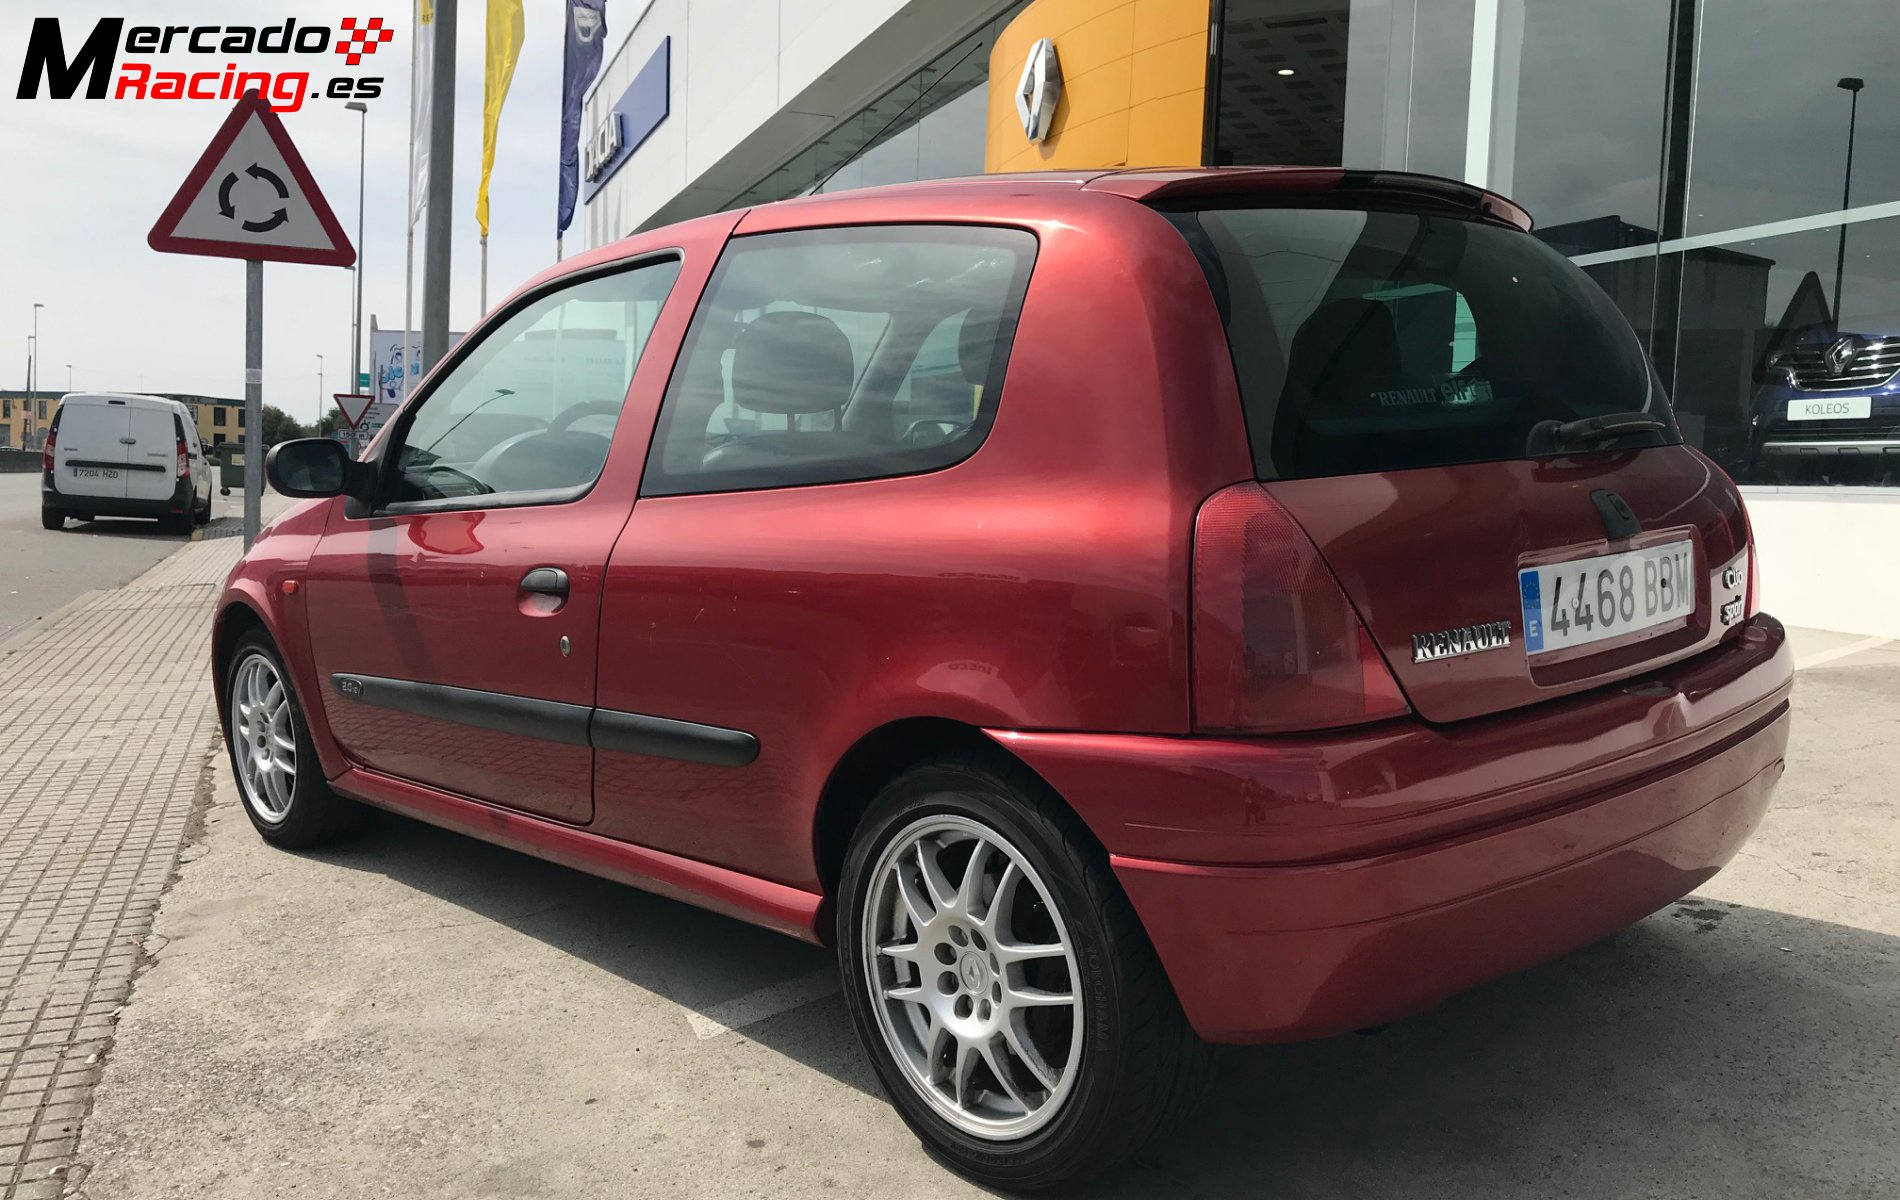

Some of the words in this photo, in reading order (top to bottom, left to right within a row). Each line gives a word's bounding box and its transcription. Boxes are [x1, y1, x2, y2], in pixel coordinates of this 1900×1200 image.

[1377, 388, 1437, 406] RENAULT
[1805, 402, 1850, 415] KOLEOS
[80, 469, 99, 478] 7204
[1551, 565, 1635, 637] 4468
[1644, 552, 1690, 618] BBM
[1529, 619, 1538, 638] E
[1412, 621, 1512, 664] RENAULT
